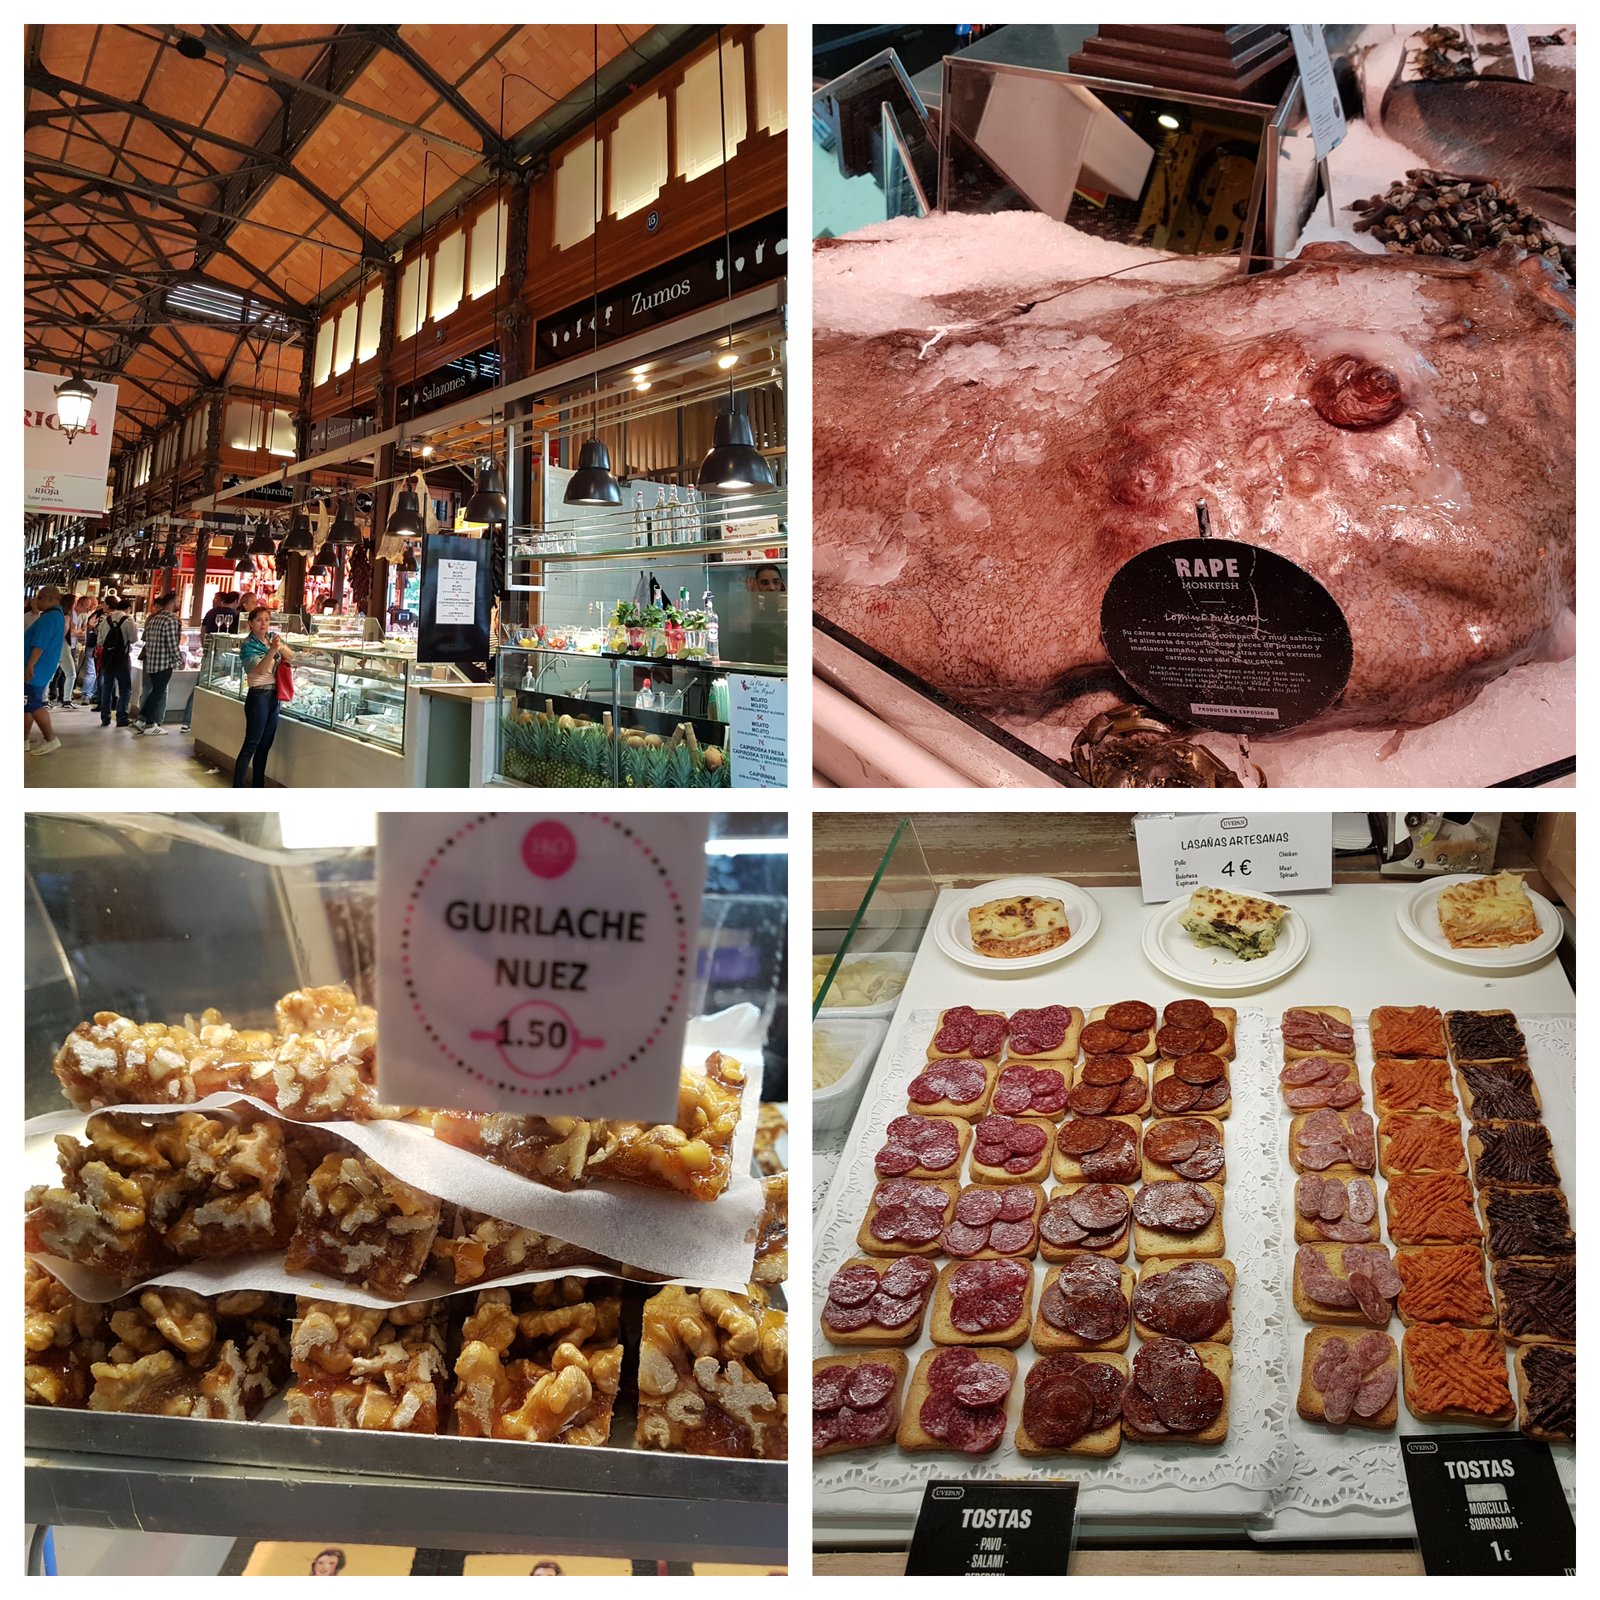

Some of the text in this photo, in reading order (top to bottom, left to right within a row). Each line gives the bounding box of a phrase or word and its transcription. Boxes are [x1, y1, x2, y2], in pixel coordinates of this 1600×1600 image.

[648, 214, 656, 227] 15
[631, 279, 691, 315] Zumos
[422, 375, 466, 402] Salazones
[1174, 558, 1240, 578] RAPE
[1181, 581, 1240, 590] MONKFISH
[1269, 634, 1287, 642] muy
[1165, 646, 1198, 654] tamaño,
[1237, 642, 1262, 650] peces
[1276, 643, 1313, 651] pequeño
[1255, 658, 1286, 666] cabeza.
[1198, 706, 1229, 714] PRODUCTO
[1239, 708, 1275, 716] EXPOSICIÓN
[732, 748, 760, 758] CAIPIROSKA
[739, 743, 785, 757] CAIPIROSKA FRESA
[759, 764, 766, 772] 7€
[749, 770, 777, 781] CAIPIRINHA
[1223, 819, 1245, 827] UVEPAN
[1181, 832, 1290, 851] LASAÑAS ARTESANAS
[1278, 850, 1299, 858] Chicken
[1279, 871, 1299, 880] Spinach
[444, 899, 647, 943] GUIRLACHE
[495, 956, 589, 992] NUEZ
[496, 1018, 569, 1049] 1.50
[1444, 1458, 1515, 1480] TOSTAS
[936, 1489, 961, 1497] UVEPAN
[1468, 1501, 1511, 1515] MORCILLA
[962, 1508, 1033, 1529] TOSTAS
[1468, 1516, 1519, 1531] SOBRASADA
[979, 1537, 1002, 1551] PAVO
[971, 1554, 1003, 1568] SALAMI
